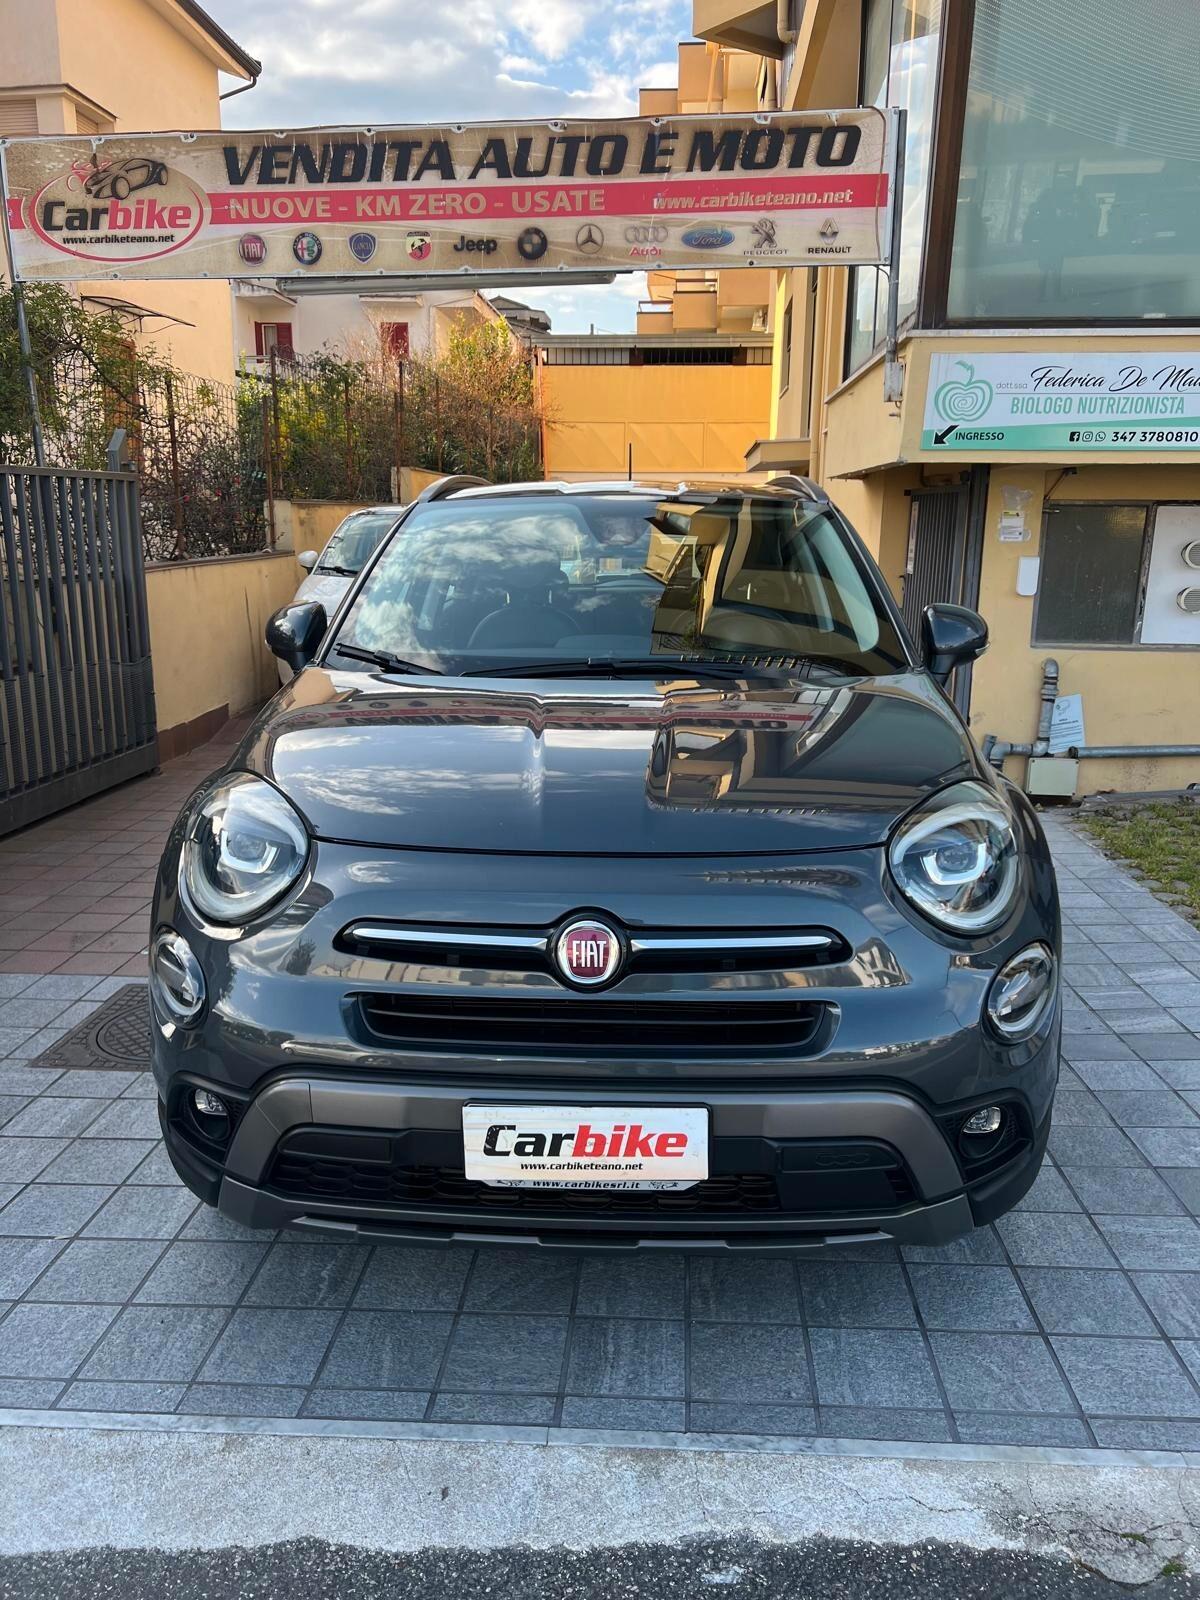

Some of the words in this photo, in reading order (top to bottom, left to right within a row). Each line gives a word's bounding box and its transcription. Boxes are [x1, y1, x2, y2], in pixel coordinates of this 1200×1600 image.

[223, 140, 455, 185] VENDITA
[467, 133, 628, 180] AUTO
[639, 132, 679, 174] E
[686, 124, 861, 173] MOTO
[229, 196, 332, 219] NUOVE
[355, 194, 401, 217] KM
[408, 192, 487, 216] ZERO
[512, 189, 606, 213] USATE
[652, 187, 854, 210] www.carbiketeano.net
[42, 199, 192, 231] Carbike
[62, 233, 175, 245] www.carbiketeano.net
[453, 235, 498, 255] Jeep
[690, 231, 722, 247] Ford
[244, 243, 261, 255] FIAT
[629, 245, 662, 257] Audi
[807, 246, 852, 255] RENAULT
[1030, 365, 1106, 392] Federica
[1108, 365, 1148, 392] De
[1010, 397, 1071, 415] BIOLOGO
[1077, 396, 1185, 415] NUTRIZIONISTA
[954, 432, 1005, 441] INGRESSO
[1111, 431, 1137, 442] 347
[1139, 431, 1199, 443] 3780810
[572, 940, 607, 968] FIAT
[483, 1124, 689, 1158] Carbike
[520, 1162, 643, 1171] www.carbiketeano.net
[532, 1180, 640, 1189] www.carbikesrl.it
